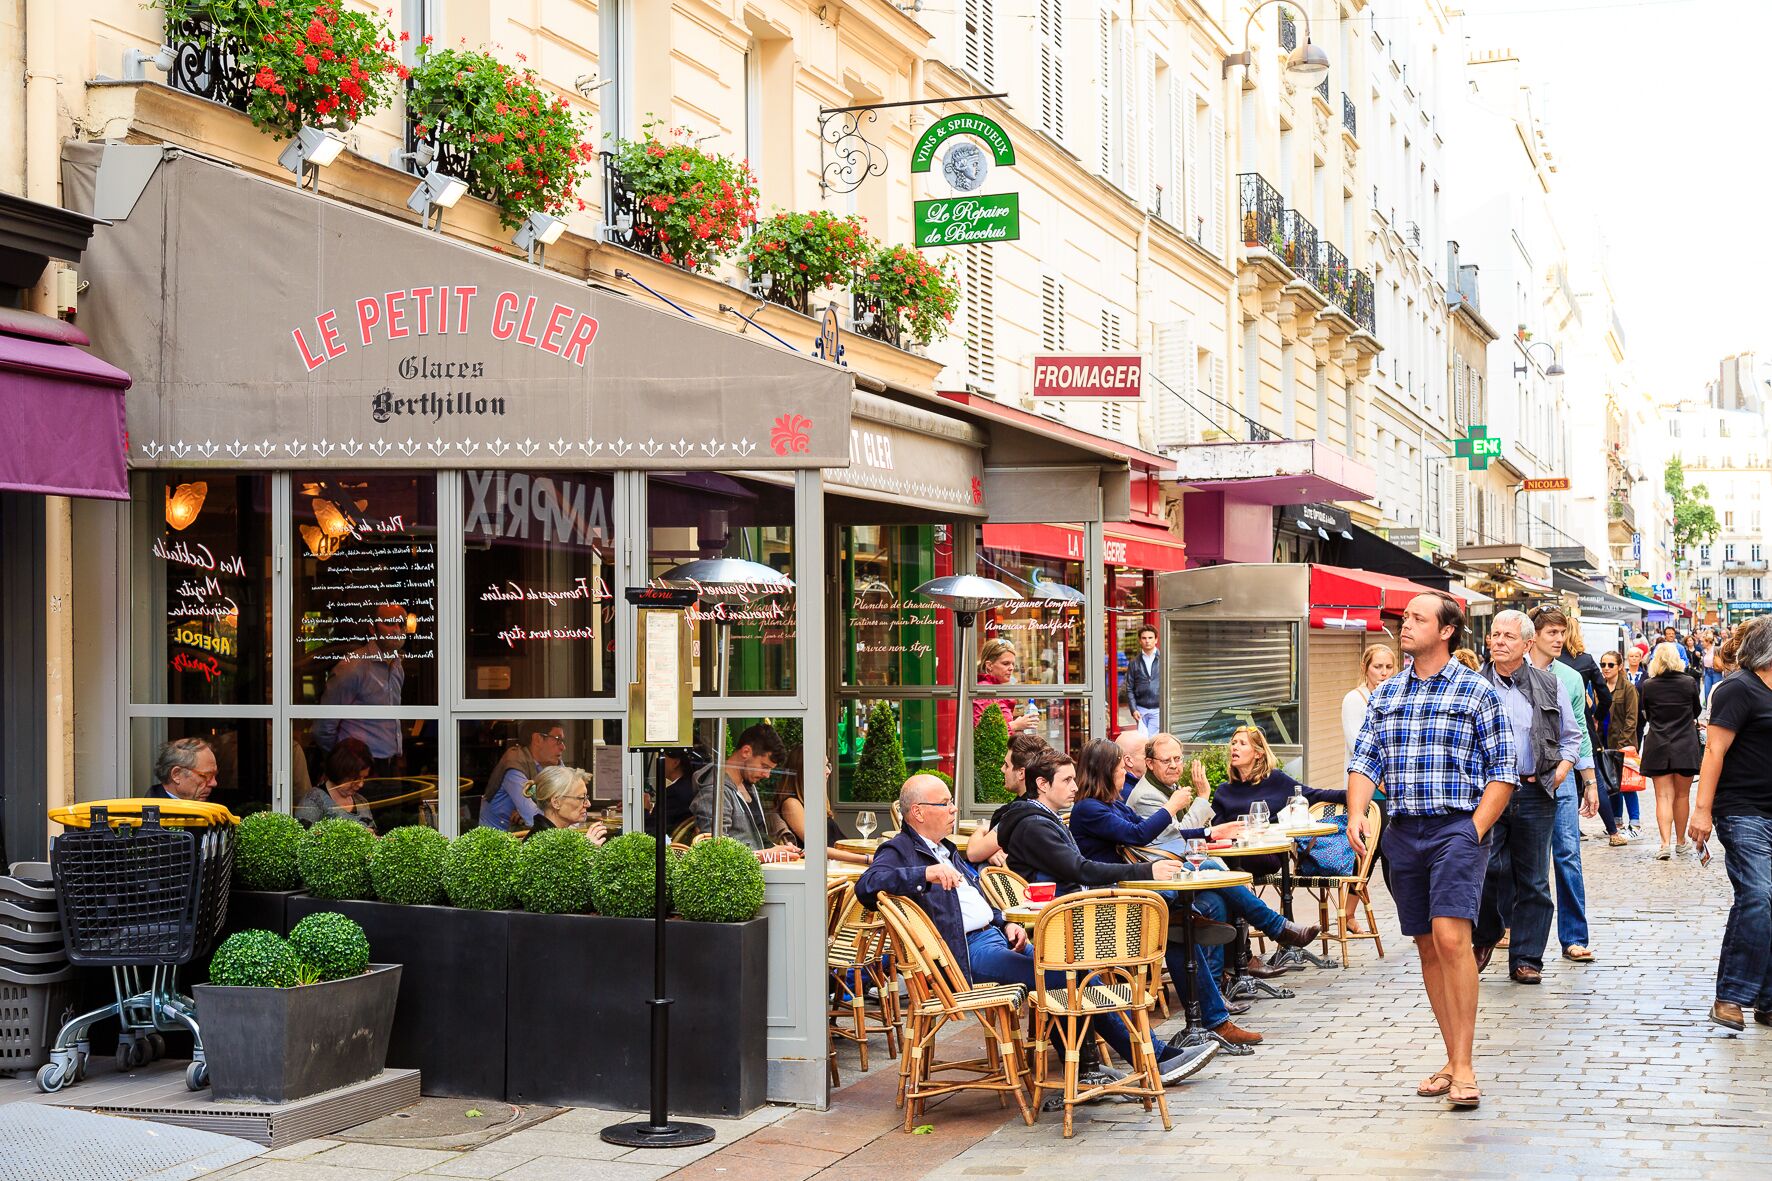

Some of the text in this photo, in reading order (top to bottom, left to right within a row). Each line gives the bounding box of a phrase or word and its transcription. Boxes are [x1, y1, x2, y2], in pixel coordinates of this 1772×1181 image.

[916, 117, 1009, 165] VINS & SPIRITUEUX
[924, 199, 1010, 224] Le Repaire
[924, 222, 1007, 244] de Bacchus
[291, 285, 600, 373] LE PETIT CLER
[398, 355, 485, 380] Glaces
[1034, 365, 1140, 388] FROMAGER
[371, 385, 506, 424] Berthillon
[864, 431, 895, 471] CLER
[1528, 480, 1565, 489] NICOLAS
[1067, 533, 1080, 557] LA
[639, 587, 673, 600] Menu
[852, 597, 889, 609] Planche
[890, 599, 901, 609] de
[1044, 597, 1080, 614] Complet
[849, 617, 878, 626] Tartines
[888, 617, 910, 631] pain
[984, 615, 1075, 636] American Breakfast
[909, 640, 932, 658] stop
